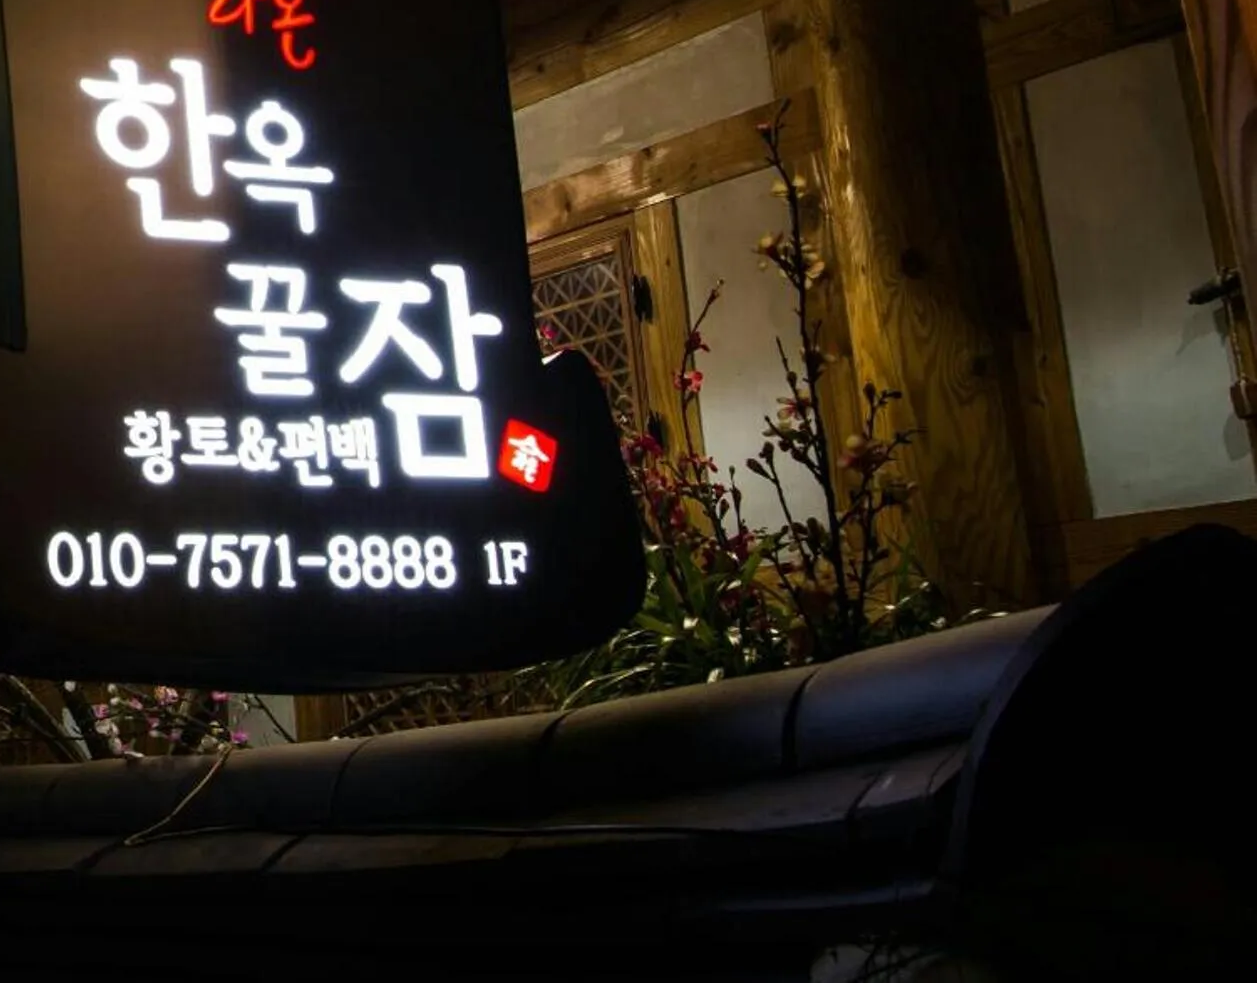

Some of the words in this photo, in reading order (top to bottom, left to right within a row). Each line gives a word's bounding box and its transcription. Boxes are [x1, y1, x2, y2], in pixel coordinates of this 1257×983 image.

[78, 58, 334, 243] 한옥
[214, 263, 503, 479] 꿀잠
[48, 532, 457, 590] 010-7571-8888
[484, 541, 528, 585] 1F
